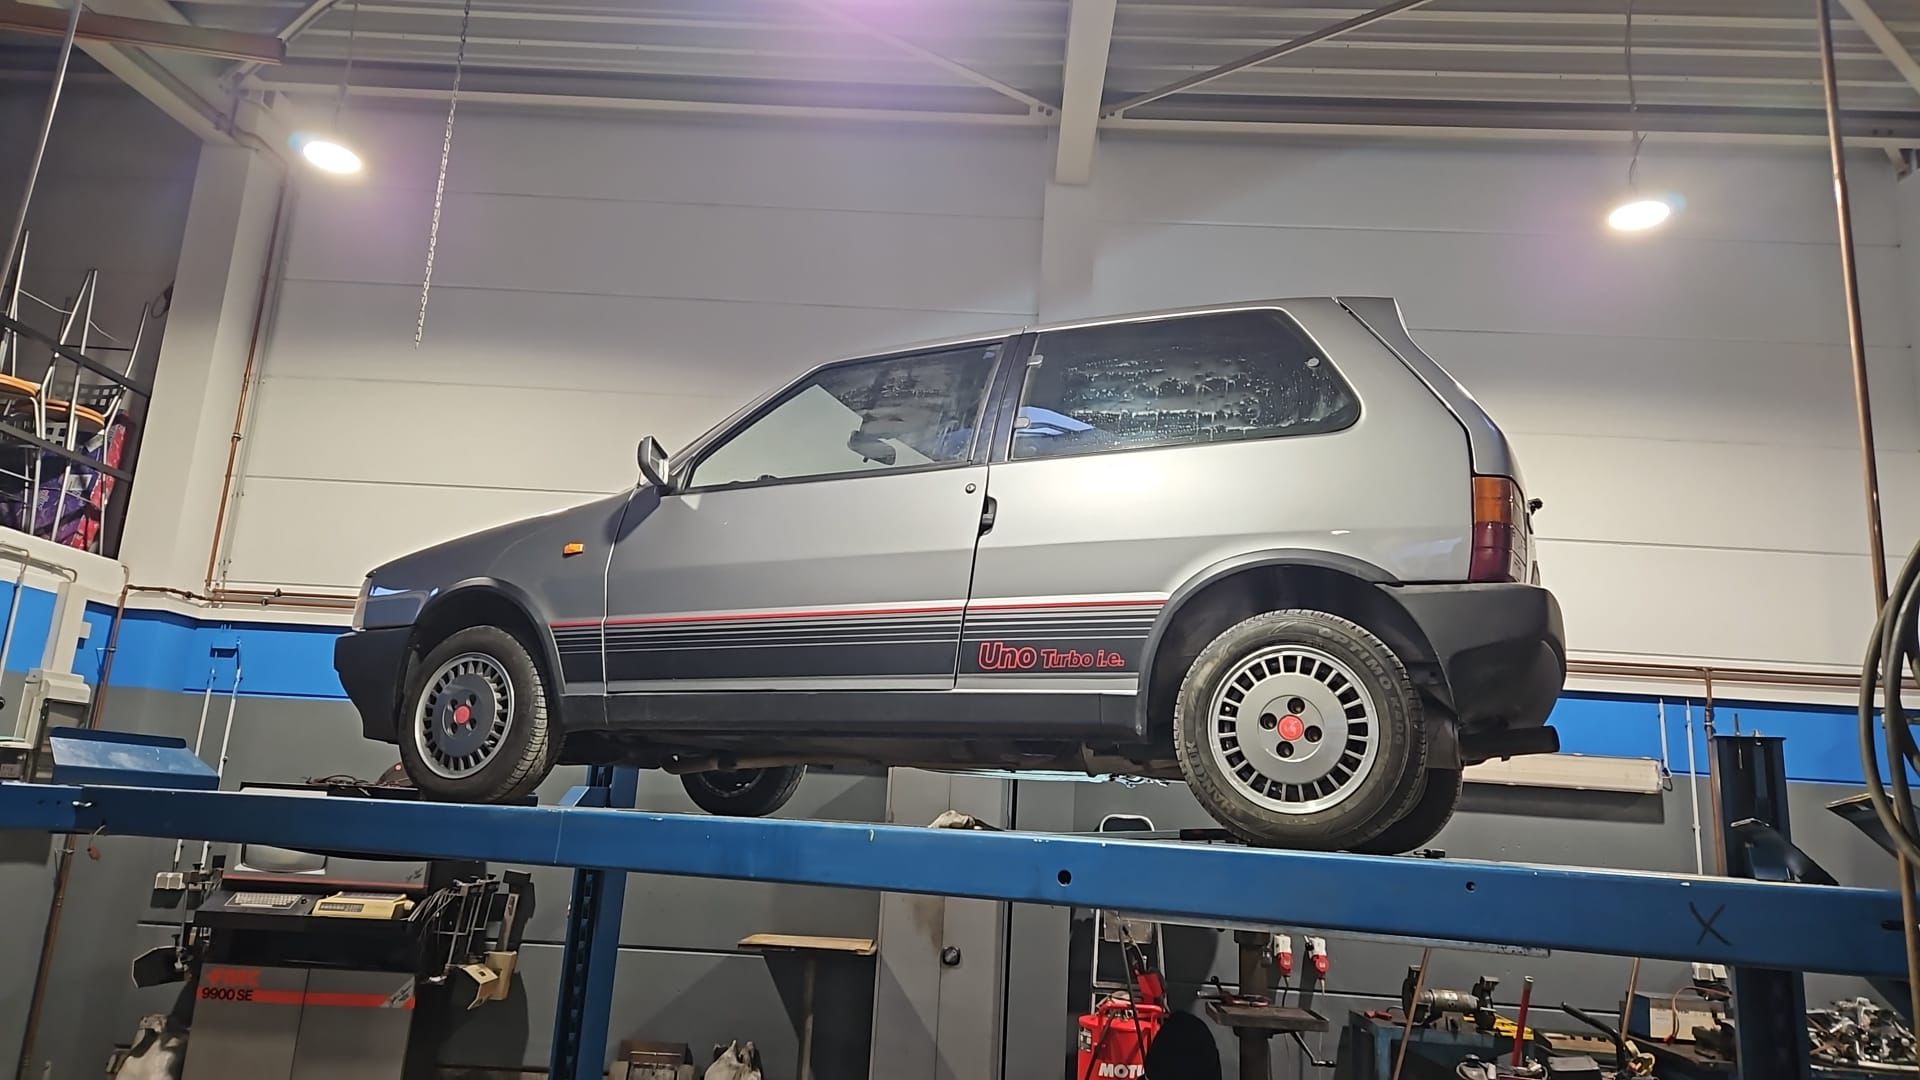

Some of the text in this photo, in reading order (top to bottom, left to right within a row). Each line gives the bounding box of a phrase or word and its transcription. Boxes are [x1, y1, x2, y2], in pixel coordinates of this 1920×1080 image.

[978, 641, 1125, 670] Uno Turbo i.e.
[1318, 627, 1393, 690] OPTIMO
[201, 987, 254, 1001] 9900 SE
[1098, 1062, 1146, 1079] MOTU
